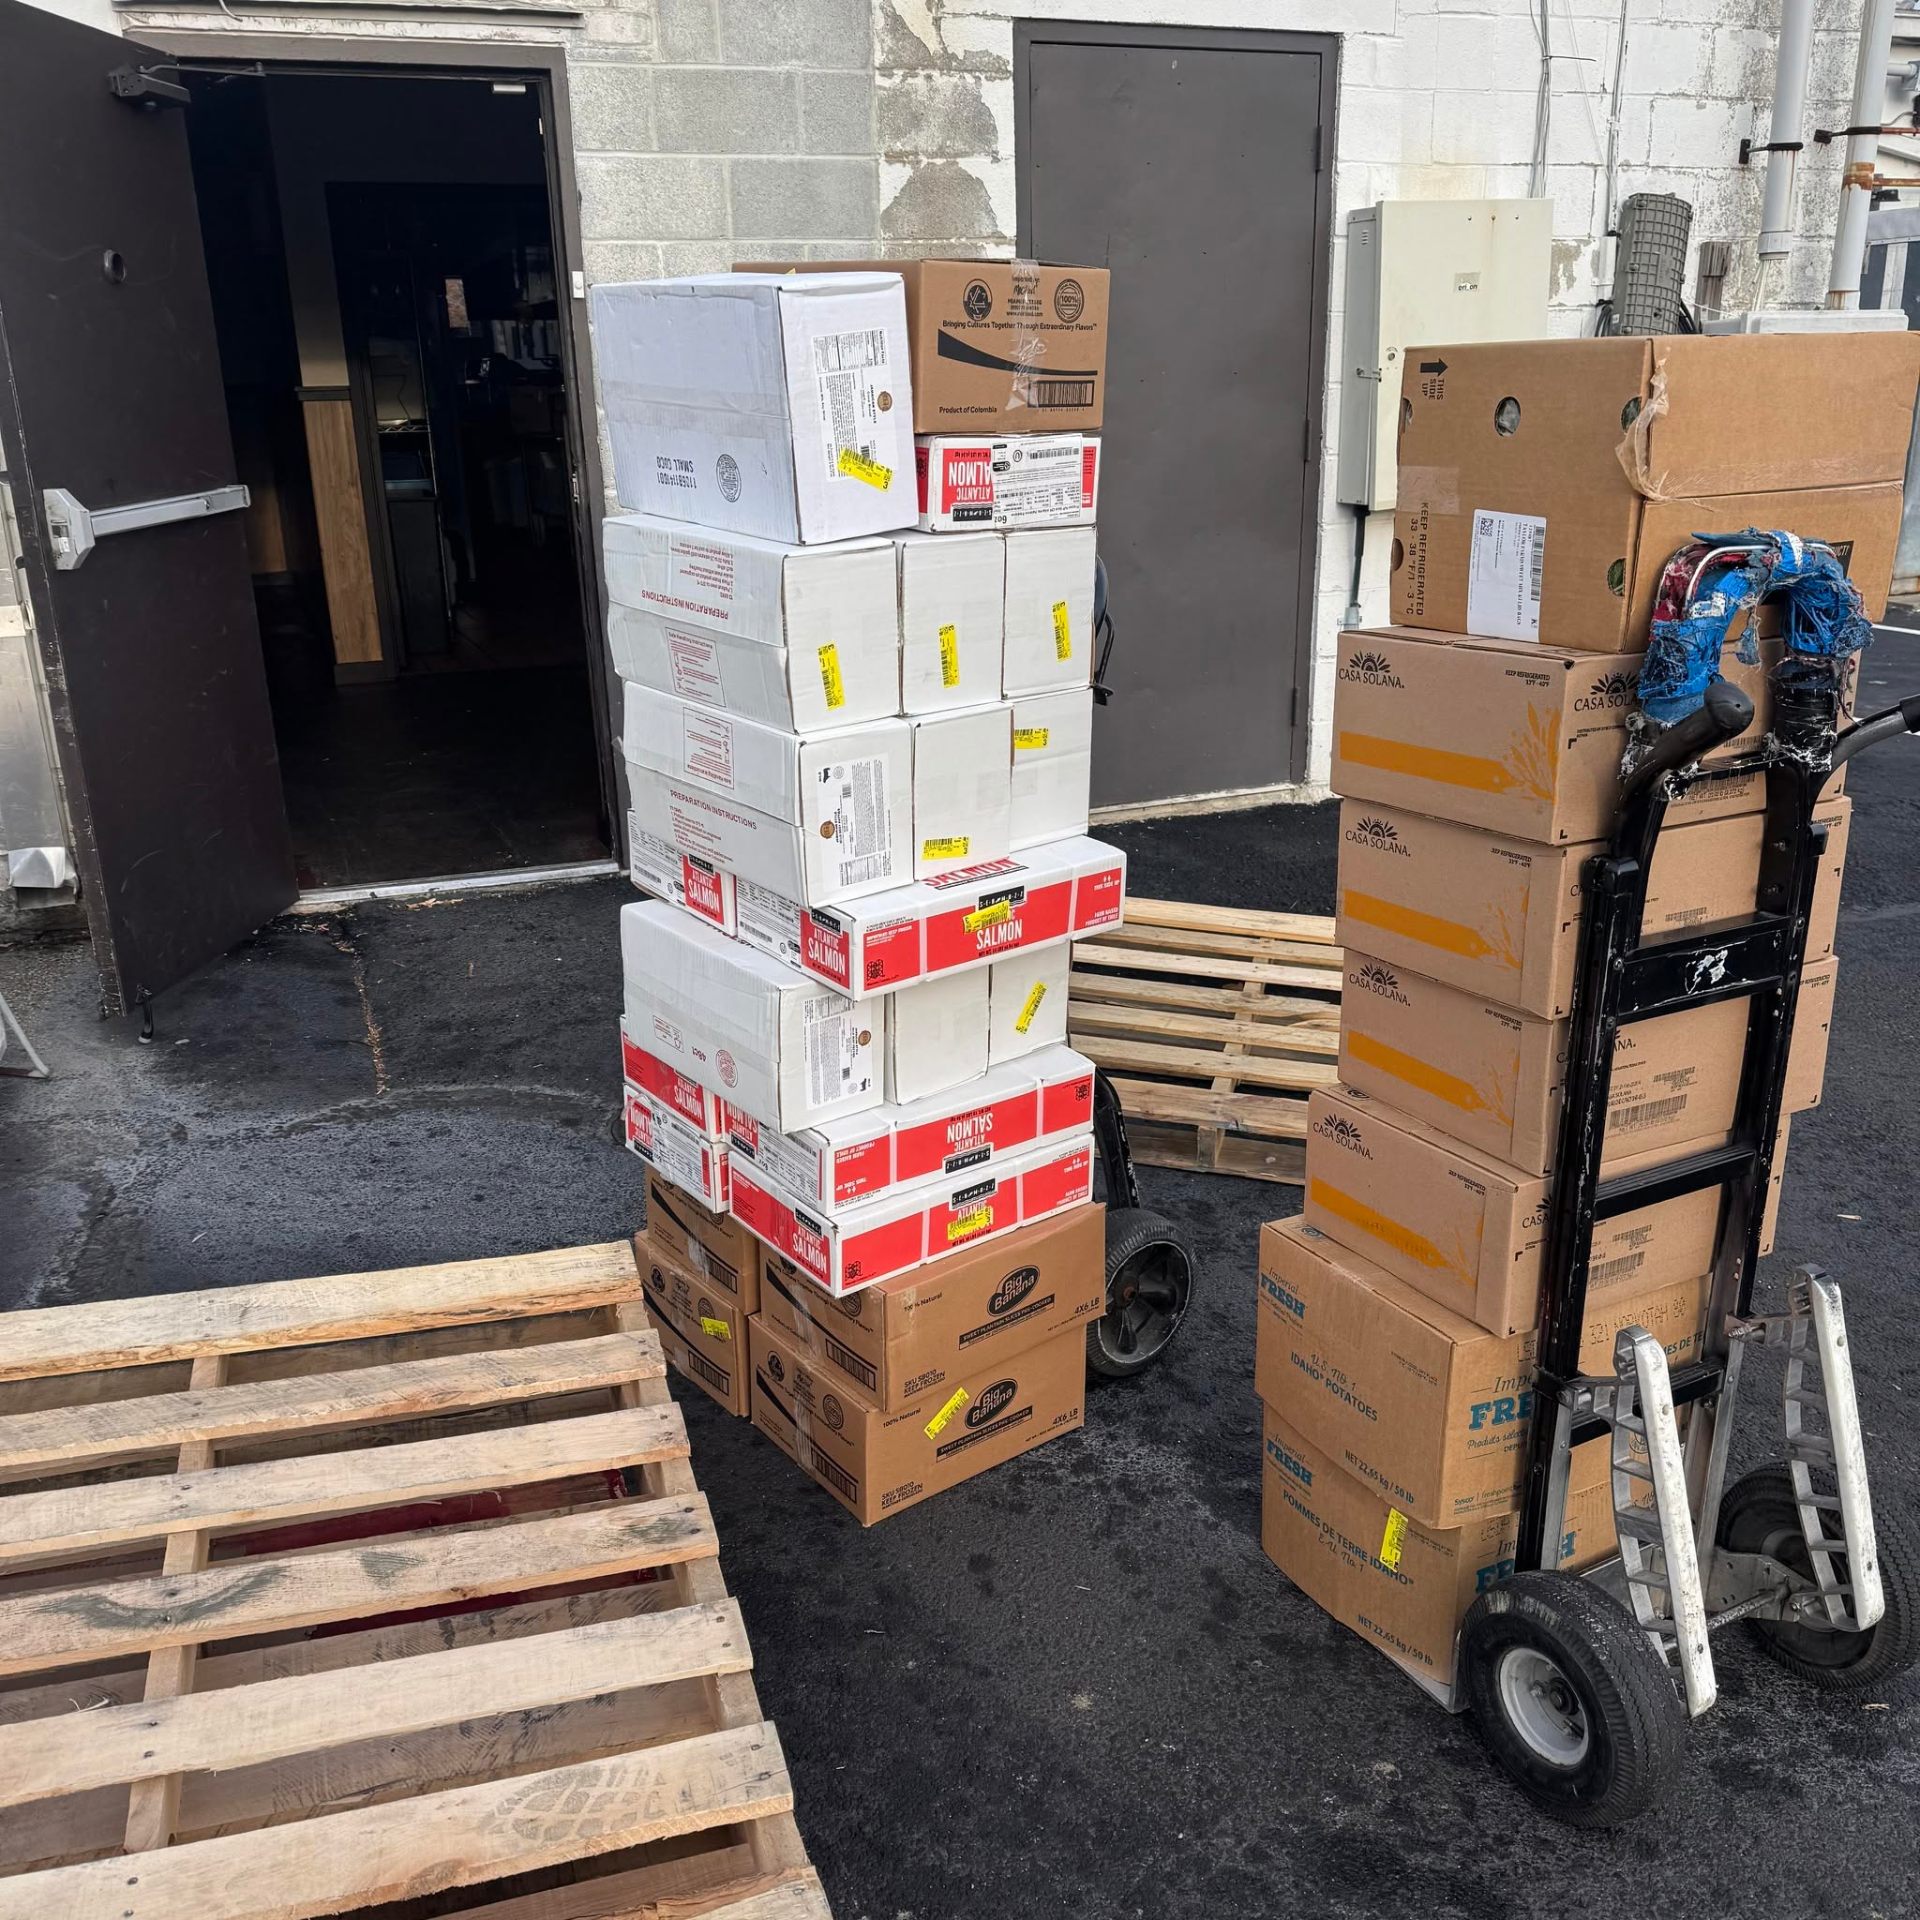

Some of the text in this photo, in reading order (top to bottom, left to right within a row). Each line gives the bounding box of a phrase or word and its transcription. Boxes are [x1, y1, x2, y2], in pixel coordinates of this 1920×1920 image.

[943, 320, 966, 330] Bringing
[967, 321, 990, 329] Cultures
[991, 322, 1015, 331] Together
[1040, 323, 1074, 331] Extraordinary
[1422, 382, 1429, 397] UP
[1437, 378, 1445, 400] THIS
[963, 405, 970, 413] of
[970, 405, 997, 413] Colombia
[673, 459, 694, 473] SMALL
[949, 462, 991, 486] ALMON
[956, 487, 991, 501] ATLANTIC
[1410, 518, 1418, 532] 33
[1409, 542, 1417, 556] 38
[1415, 502, 1429, 616] KEEP REFRIGERATED
[641, 589, 729, 620] PREPARATION INSTRUCTIONS
[1338, 668, 1361, 682] CASA
[1574, 696, 1606, 712] CASA
[670, 789, 757, 830] PREPARATION INSTRUCTIONS
[1345, 830, 1368, 846] CASA
[692, 869, 714, 889] ATLANTIC
[689, 881, 720, 913] SALMON
[813, 928, 839, 948] ATLANTIC
[976, 918, 1023, 950] SALMON
[808, 939, 846, 976] SALMON
[1349, 973, 1371, 991] CASA
[674, 1084, 703, 1120] SALMON
[732, 1119, 754, 1142] ATLANTIC
[947, 1113, 994, 1144] SALMON
[1313, 1122, 1334, 1143] CASA
[954, 1133, 986, 1152] ATLANTIC
[1522, 1212, 1550, 1229] CASA
[798, 1225, 821, 1249] ATLANTIC
[793, 1233, 827, 1274] SALMON
[1005, 1273, 1024, 1293] Big
[1268, 1267, 1299, 1295] Imperial
[921, 1292, 943, 1306] Natural
[994, 1275, 1035, 1310] Banana
[1260, 1272, 1306, 1320] FRESH
[1074, 1297, 1100, 1314] 4X6 LB
[963, 1329, 980, 1341] SWEET
[1679, 1338, 1692, 1350] DE
[904, 1378, 916, 1388] SKU
[904, 1371, 946, 1395] KEEP FROZEN
[1351, 1382, 1357, 1392] 1
[1492, 1376, 1533, 1394] Impe
[972, 1388, 1013, 1424] Banana
[982, 1388, 1000, 1407] Big
[1325, 1378, 1379, 1422] POTATOES
[883, 1408, 921, 1428] 100% Natural
[1052, 1408, 1079, 1425] 4X6 LB
[1469, 1391, 1533, 1431] FRE
[1467, 1436, 1500, 1450] Produits
[1266, 1438, 1313, 1487] FRESH
[1345, 1449, 1358, 1466] NET
[1379, 1474, 1389, 1490] kg
[1394, 1485, 1404, 1498] 50
[1406, 1491, 1414, 1504] lb
[881, 1483, 923, 1506] KEEP FROZEN
[882, 1490, 893, 1500] SKU
[1454, 1494, 1475, 1506] Sysco
[1283, 1489, 1321, 1527] POMMES
[1322, 1521, 1335, 1538] DE
[1336, 1534, 1368, 1561] TERRE
[1359, 1563, 1365, 1573] 1
[1358, 1614, 1372, 1629] NET
[1396, 1638, 1406, 1653] kg
[1412, 1648, 1423, 1660] 50
[1425, 1654, 1433, 1665] lb
